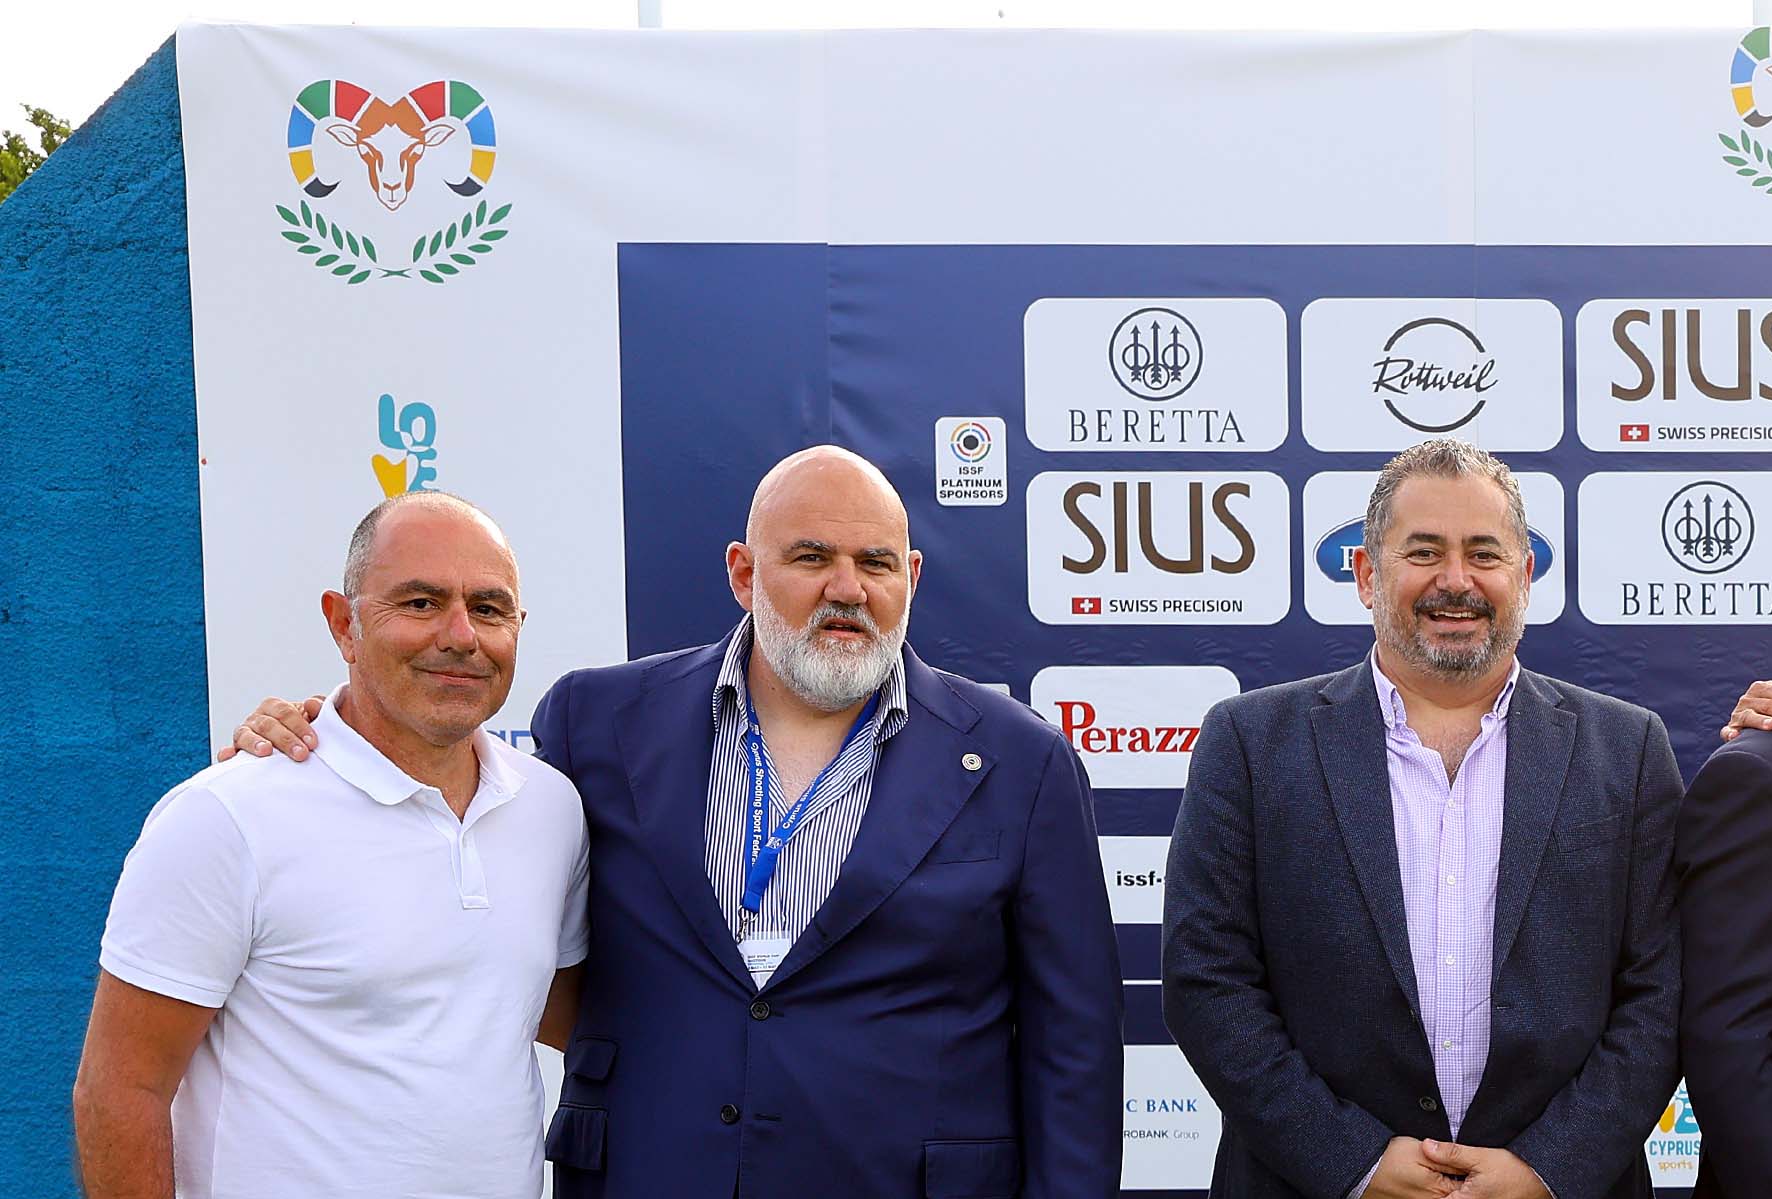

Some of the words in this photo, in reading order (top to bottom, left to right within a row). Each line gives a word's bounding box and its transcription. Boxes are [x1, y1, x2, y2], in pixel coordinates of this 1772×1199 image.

[1372, 356, 1498, 395] Rottweil
[1068, 409, 1245, 443] BERETTA
[1657, 427, 1706, 440] SWISS
[958, 466, 984, 475] ISSF
[941, 479, 1002, 488] PLATINUM
[939, 489, 1004, 499] SPONSORS
[1062, 482, 1256, 574] SIUS
[1109, 600, 1158, 613] SWISS
[1163, 600, 1243, 613] PRECISION
[1054, 701, 1201, 752] Perazz
[753, 768, 765, 808] Shooting
[752, 809, 764, 833] Sport
[1146, 1099, 1198, 1113] BANK
[1123, 1130, 1169, 1139] ROBANK
[1173, 1130, 1200, 1140] Group
[1649, 1140, 1701, 1156] CYPRUS
